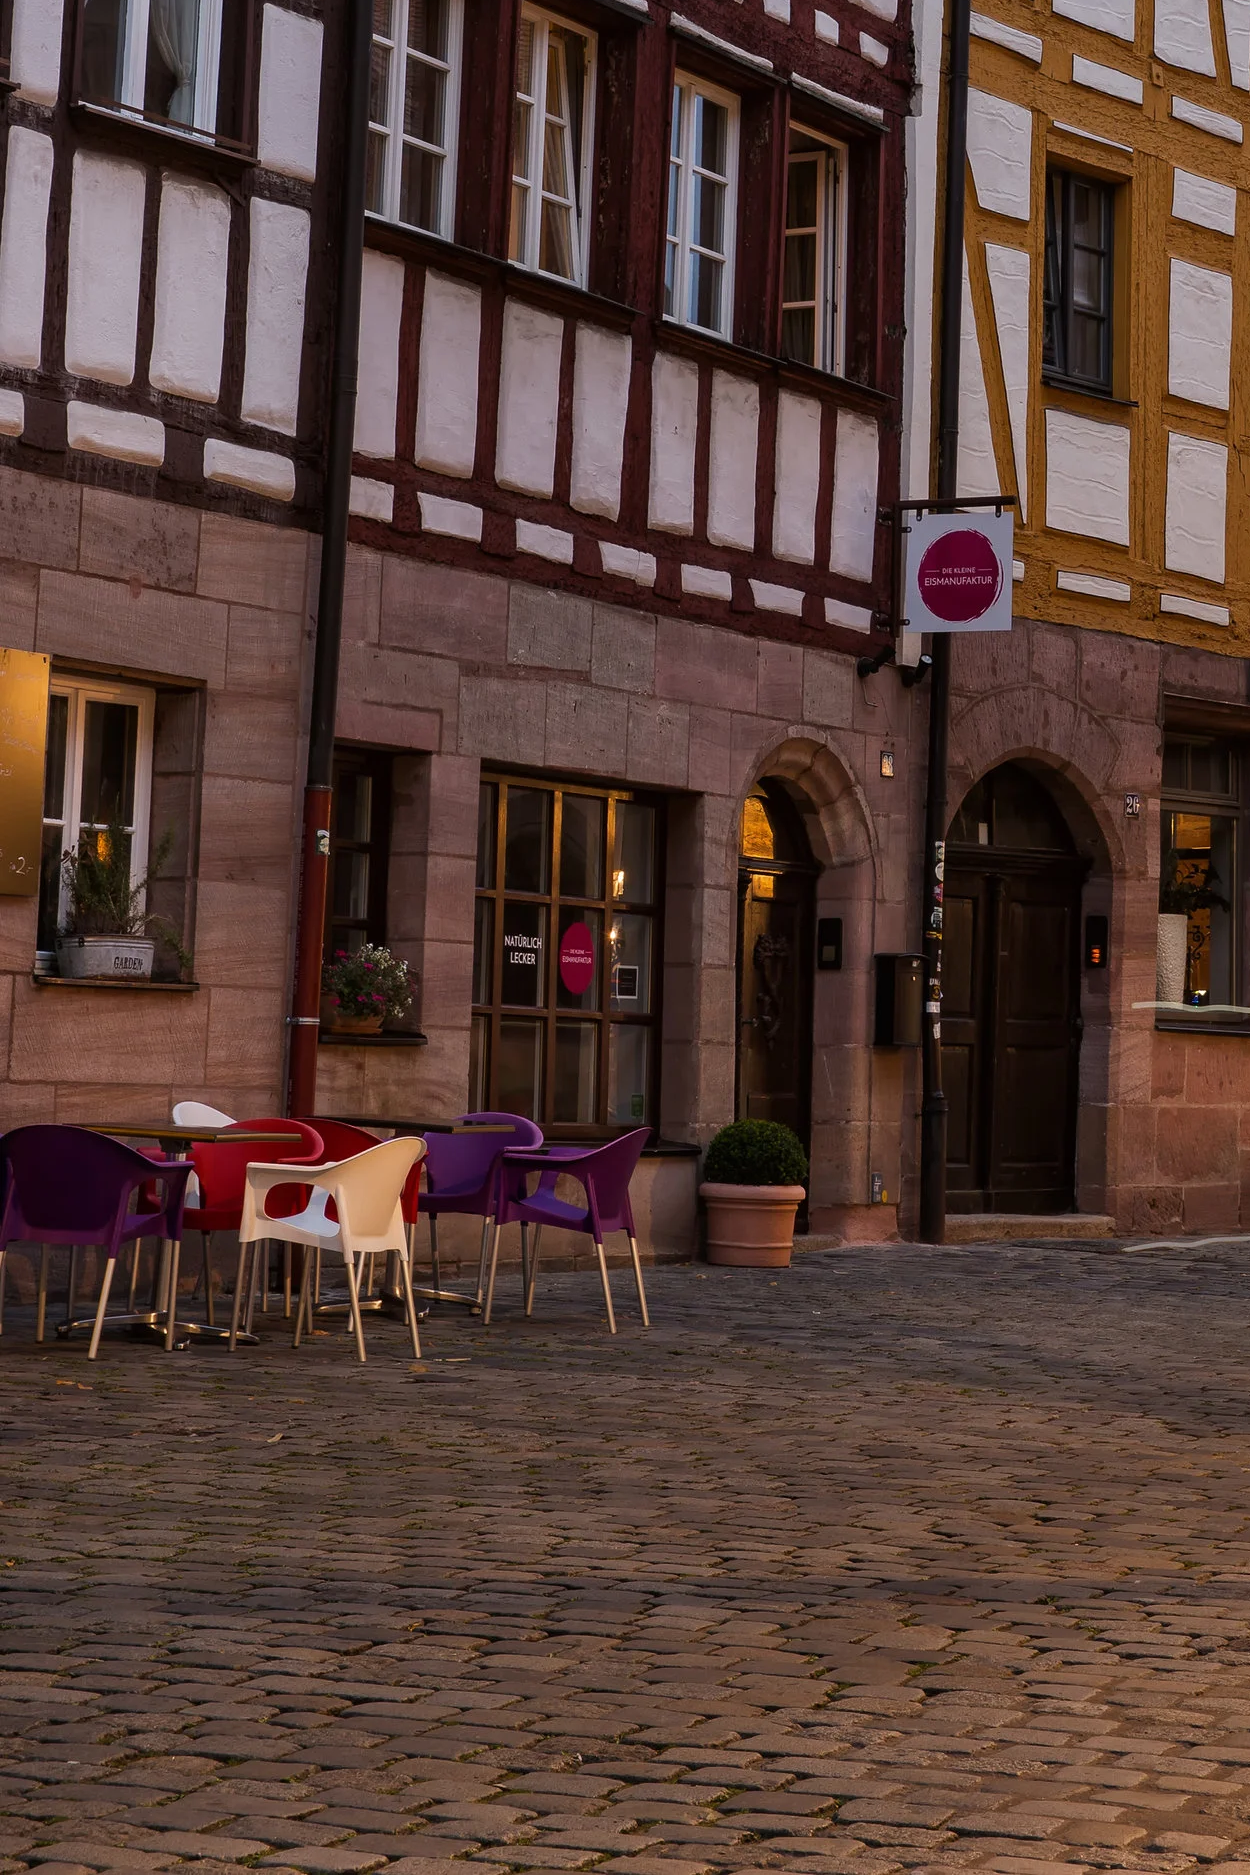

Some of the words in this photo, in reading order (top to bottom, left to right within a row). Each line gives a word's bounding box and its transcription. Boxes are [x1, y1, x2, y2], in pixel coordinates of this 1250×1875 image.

[924, 576, 993, 586] EISMANUFAKTUR
[1127, 796, 1139, 813] 26
[504, 934, 542, 949] NATÜRLICH
[113, 956, 143, 971] GARDEN
[510, 952, 536, 965] LECKER
